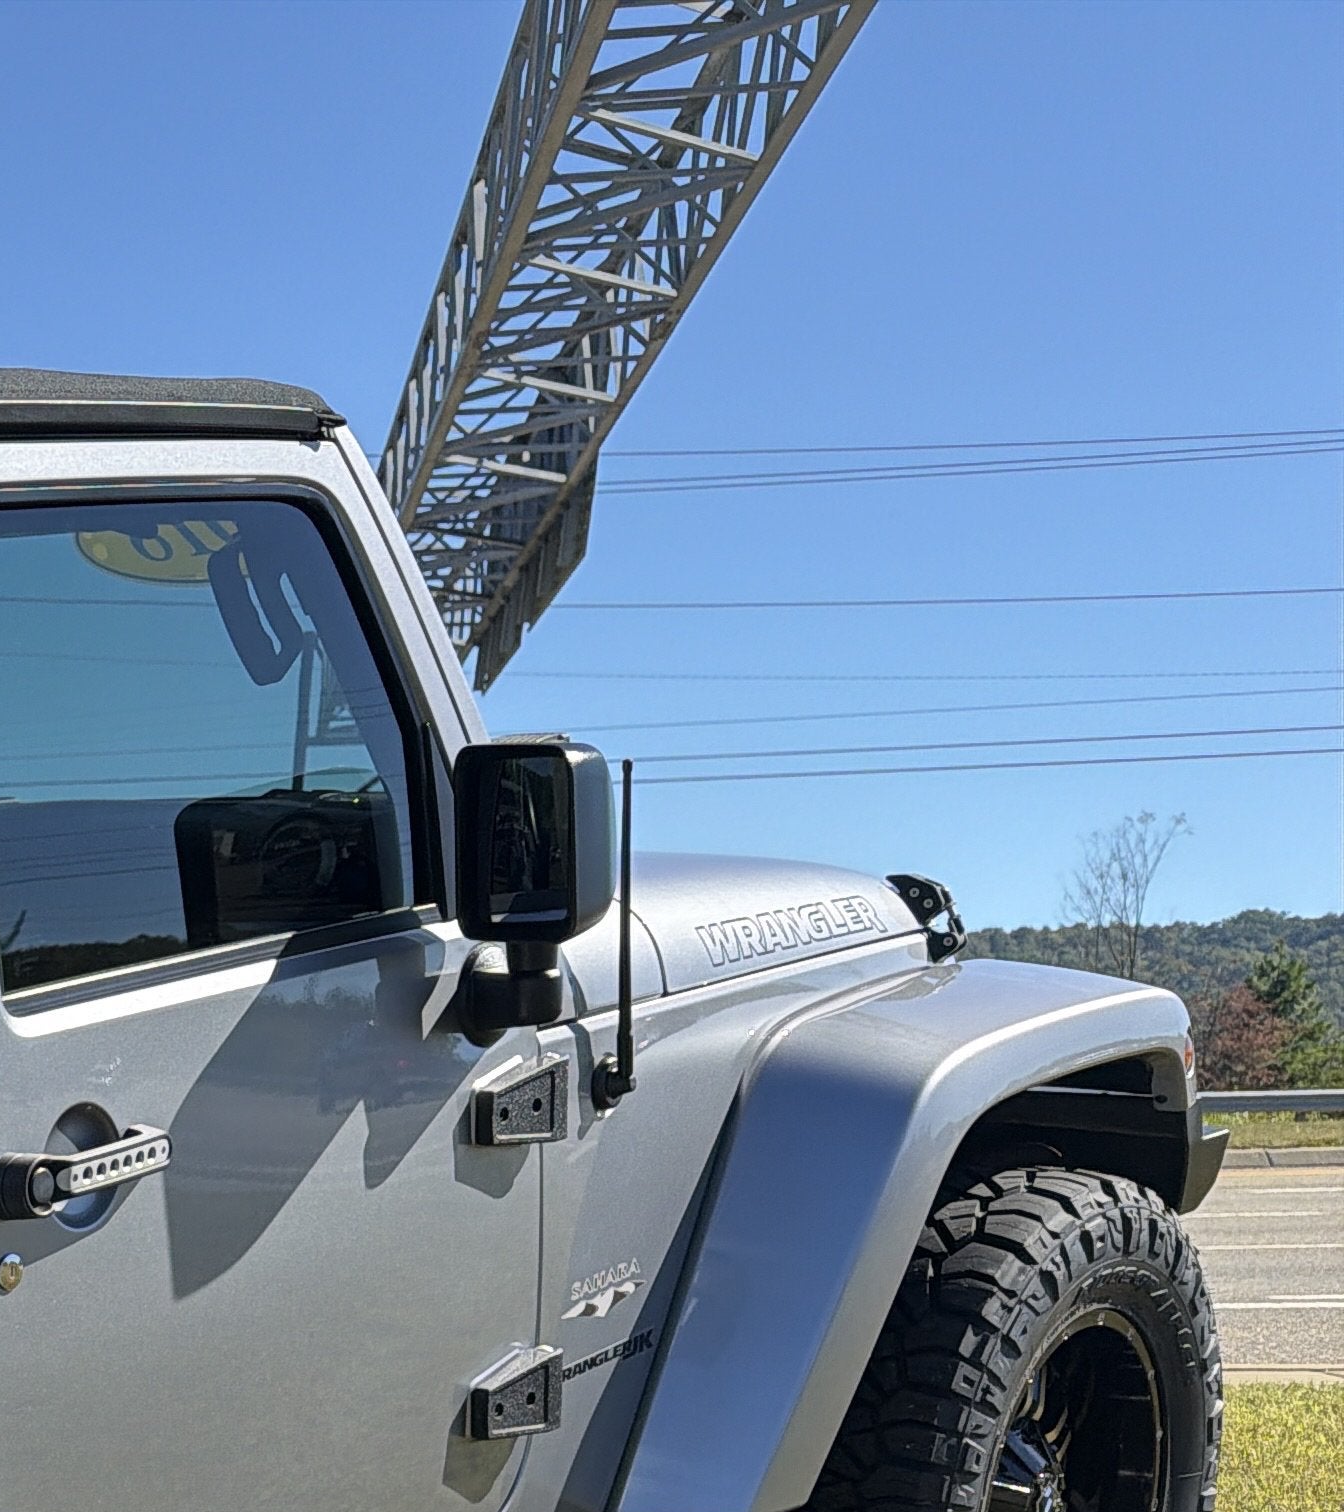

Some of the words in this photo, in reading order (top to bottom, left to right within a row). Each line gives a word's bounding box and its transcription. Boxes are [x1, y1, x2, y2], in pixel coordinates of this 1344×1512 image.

[695, 895, 888, 967] WRANGLER
[571, 1257, 641, 1300] SAHARA
[623, 1328, 655, 1360] JK
